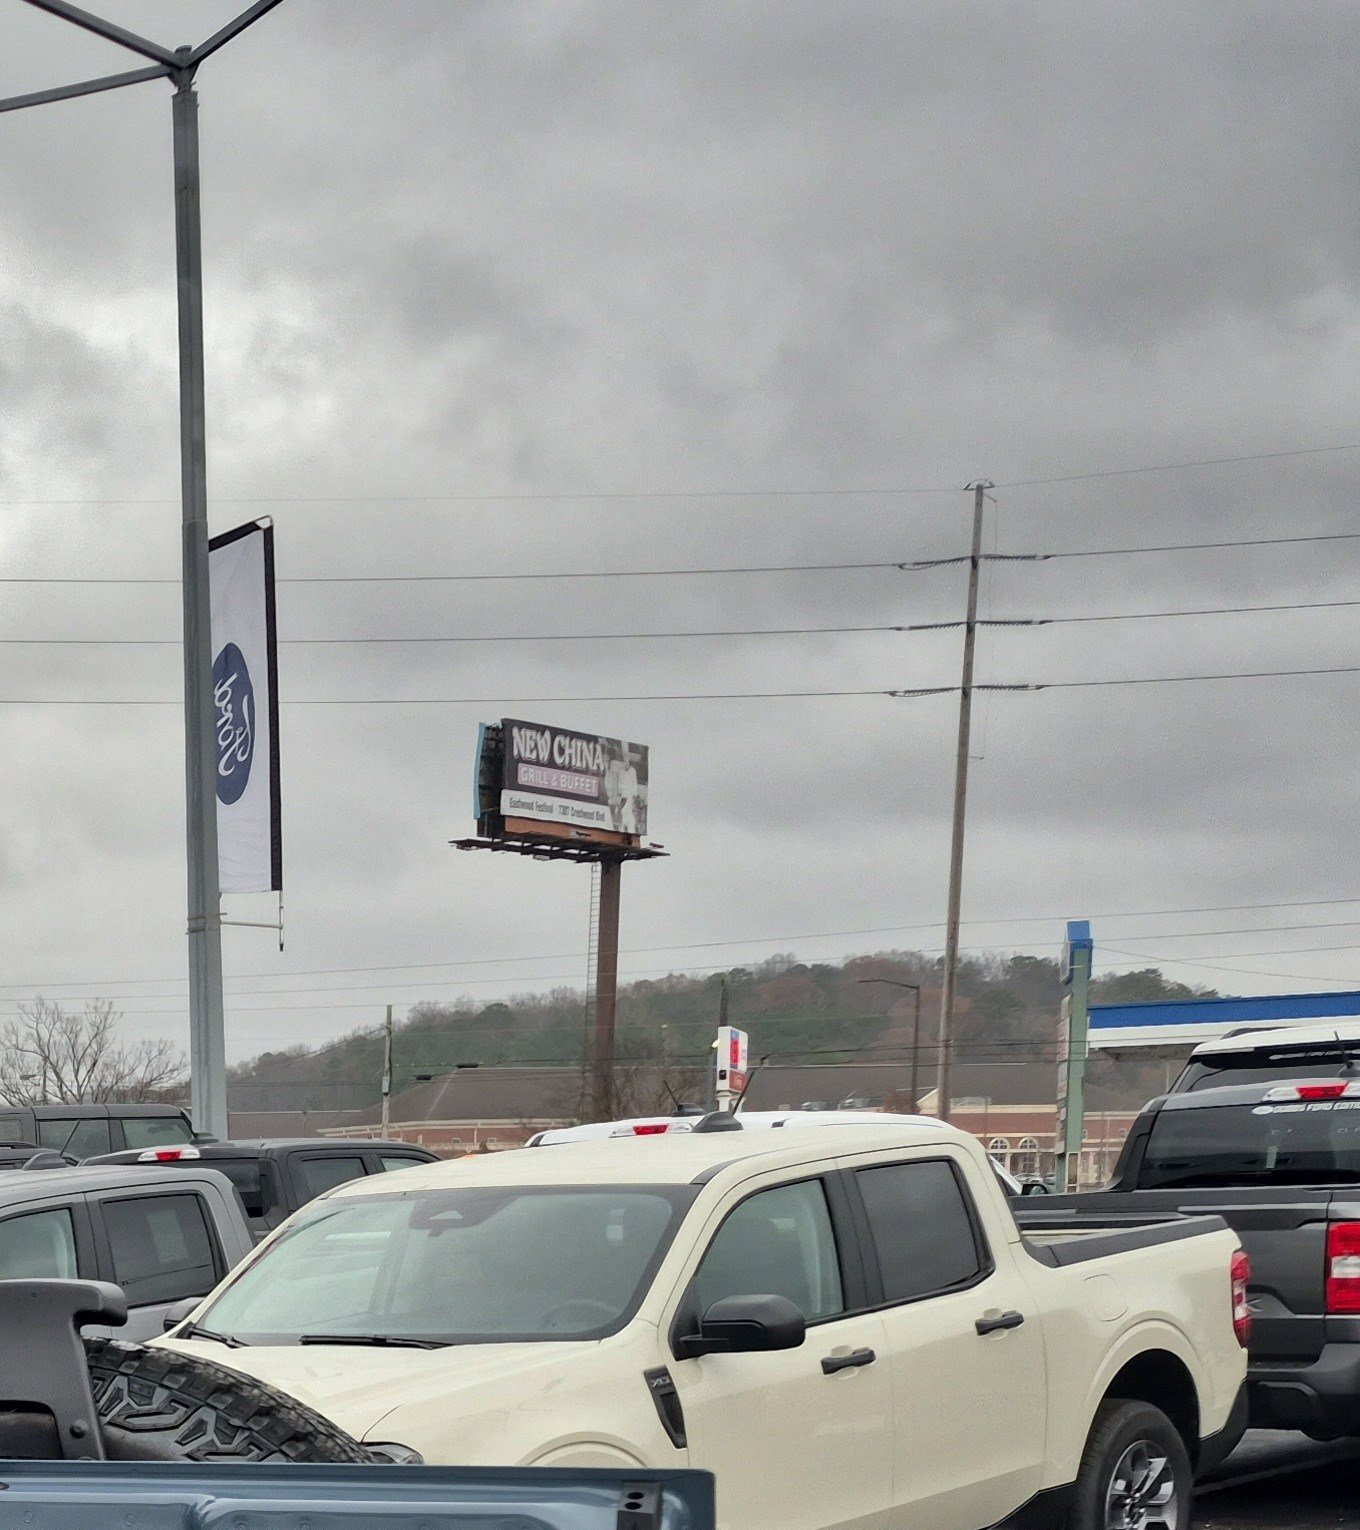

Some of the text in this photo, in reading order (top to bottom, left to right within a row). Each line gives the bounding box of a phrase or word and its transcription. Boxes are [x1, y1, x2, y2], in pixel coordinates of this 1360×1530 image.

[512, 726, 606, 773] NEW CHINA
[521, 766, 549, 785] GRILL
[560, 774, 597, 793] BUFFET
